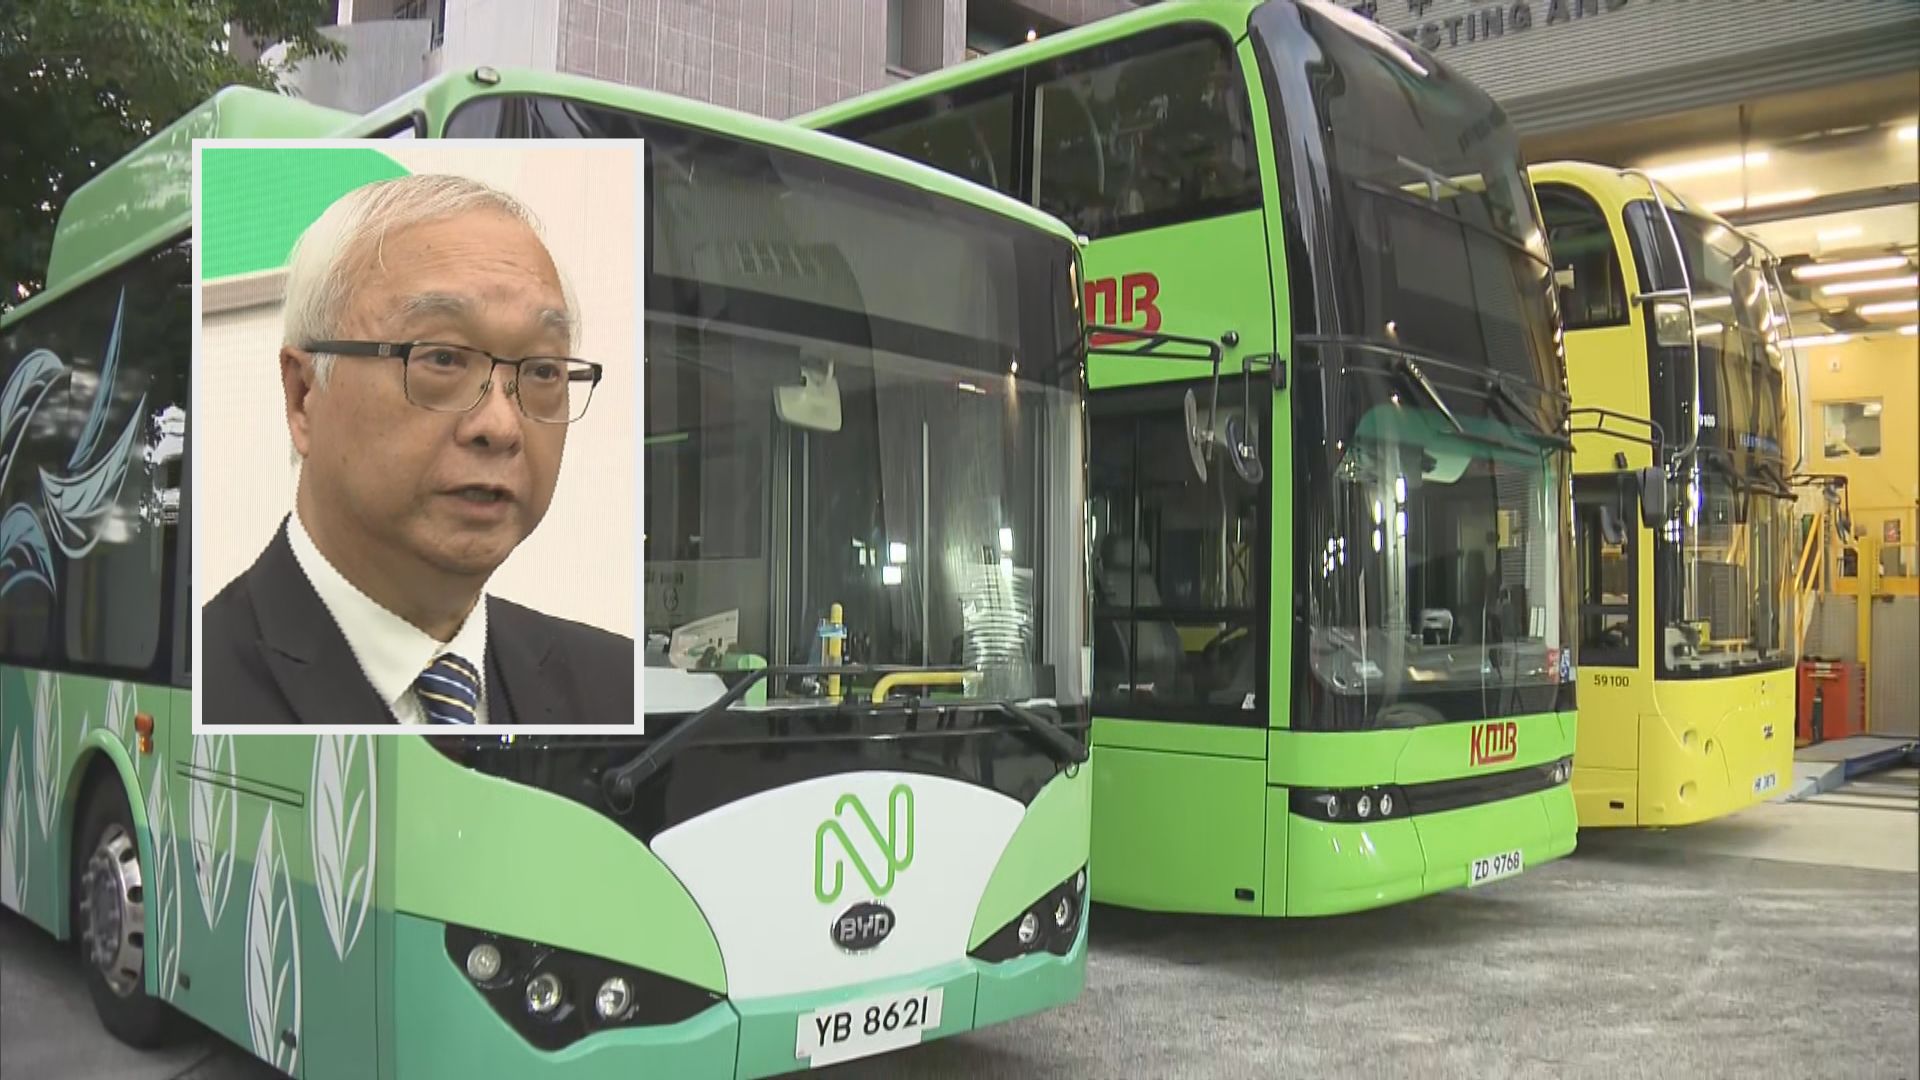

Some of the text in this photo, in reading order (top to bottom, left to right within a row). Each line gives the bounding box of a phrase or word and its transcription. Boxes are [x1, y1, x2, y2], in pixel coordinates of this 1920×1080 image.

[1084, 272, 1162, 347] MB
[1593, 674, 1630, 688] 59100
[1470, 722, 1517, 767] KMB
[1475, 851, 1520, 880] ZD 9768
[839, 912, 890, 942] BYD
[816, 995, 929, 1047] YB 8621
